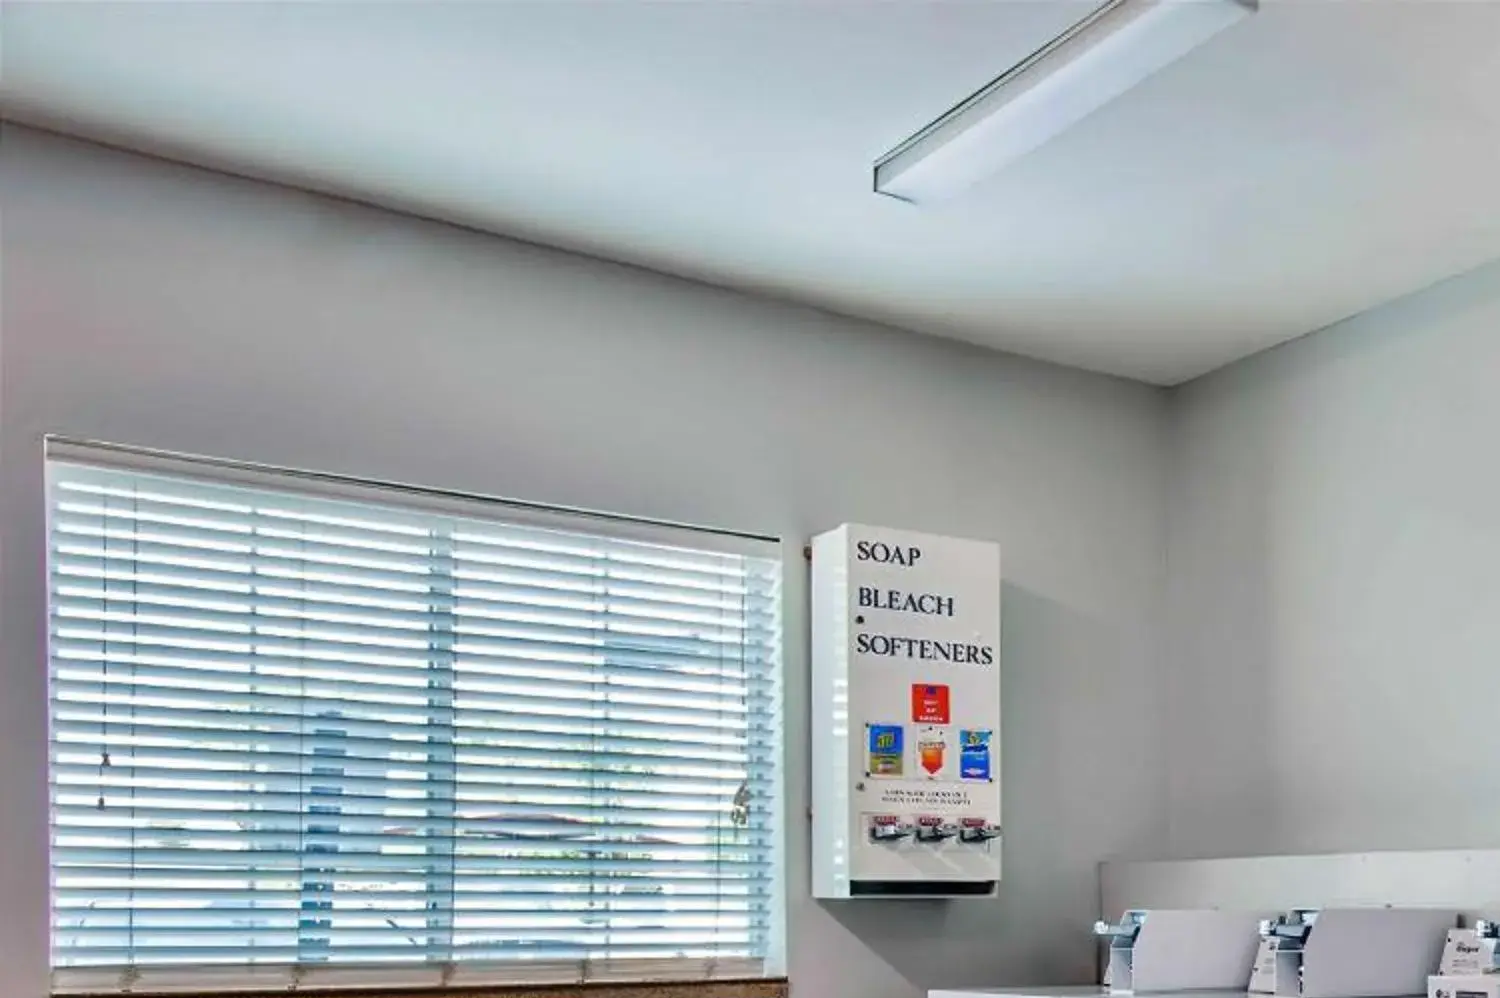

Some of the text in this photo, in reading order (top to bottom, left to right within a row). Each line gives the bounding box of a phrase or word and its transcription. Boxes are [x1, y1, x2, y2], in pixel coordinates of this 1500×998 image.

[857, 540, 921, 568] SOAP
[858, 587, 955, 618] BLEACH
[857, 633, 994, 666] SOFTENERS
